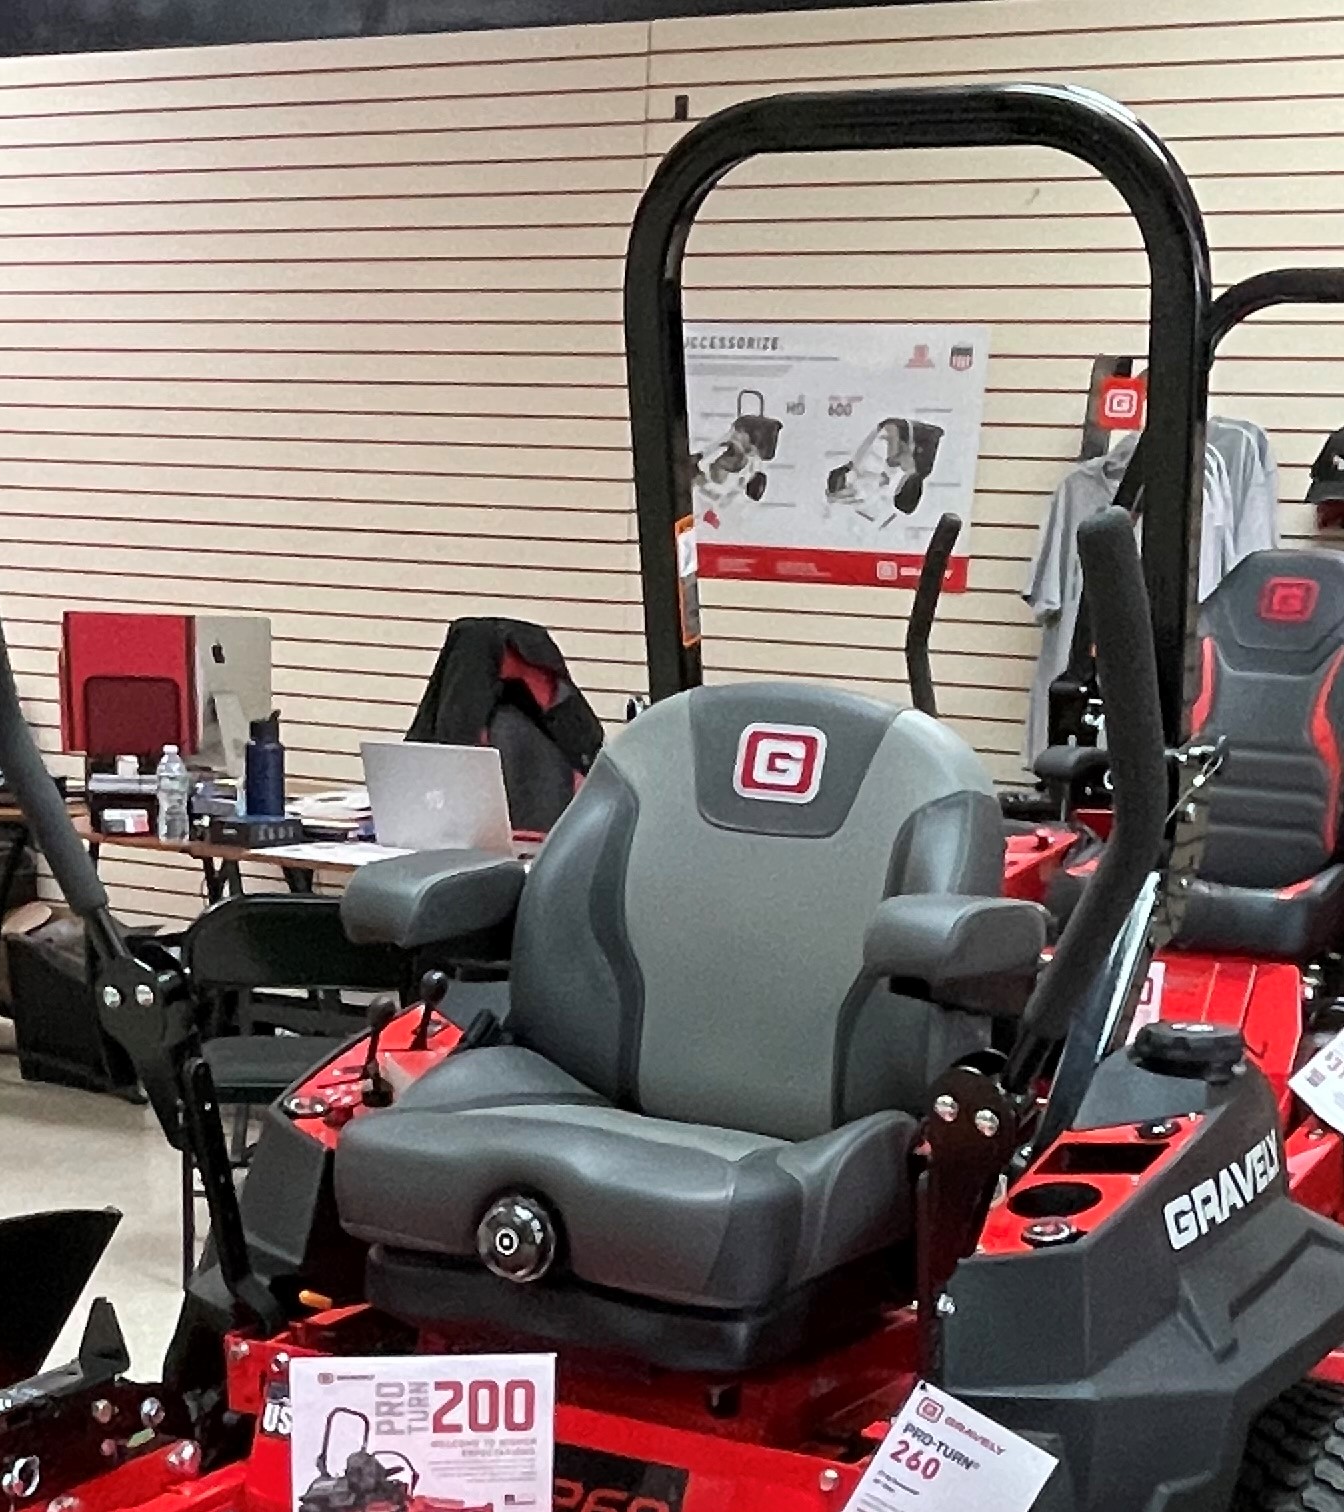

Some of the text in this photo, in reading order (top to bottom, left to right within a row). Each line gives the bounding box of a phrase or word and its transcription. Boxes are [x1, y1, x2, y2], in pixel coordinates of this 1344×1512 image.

[374, 1380, 406, 1436] PRO
[407, 1380, 430, 1434] TURN
[432, 1379, 536, 1434] 200
[890, 1440, 942, 1480] 260
